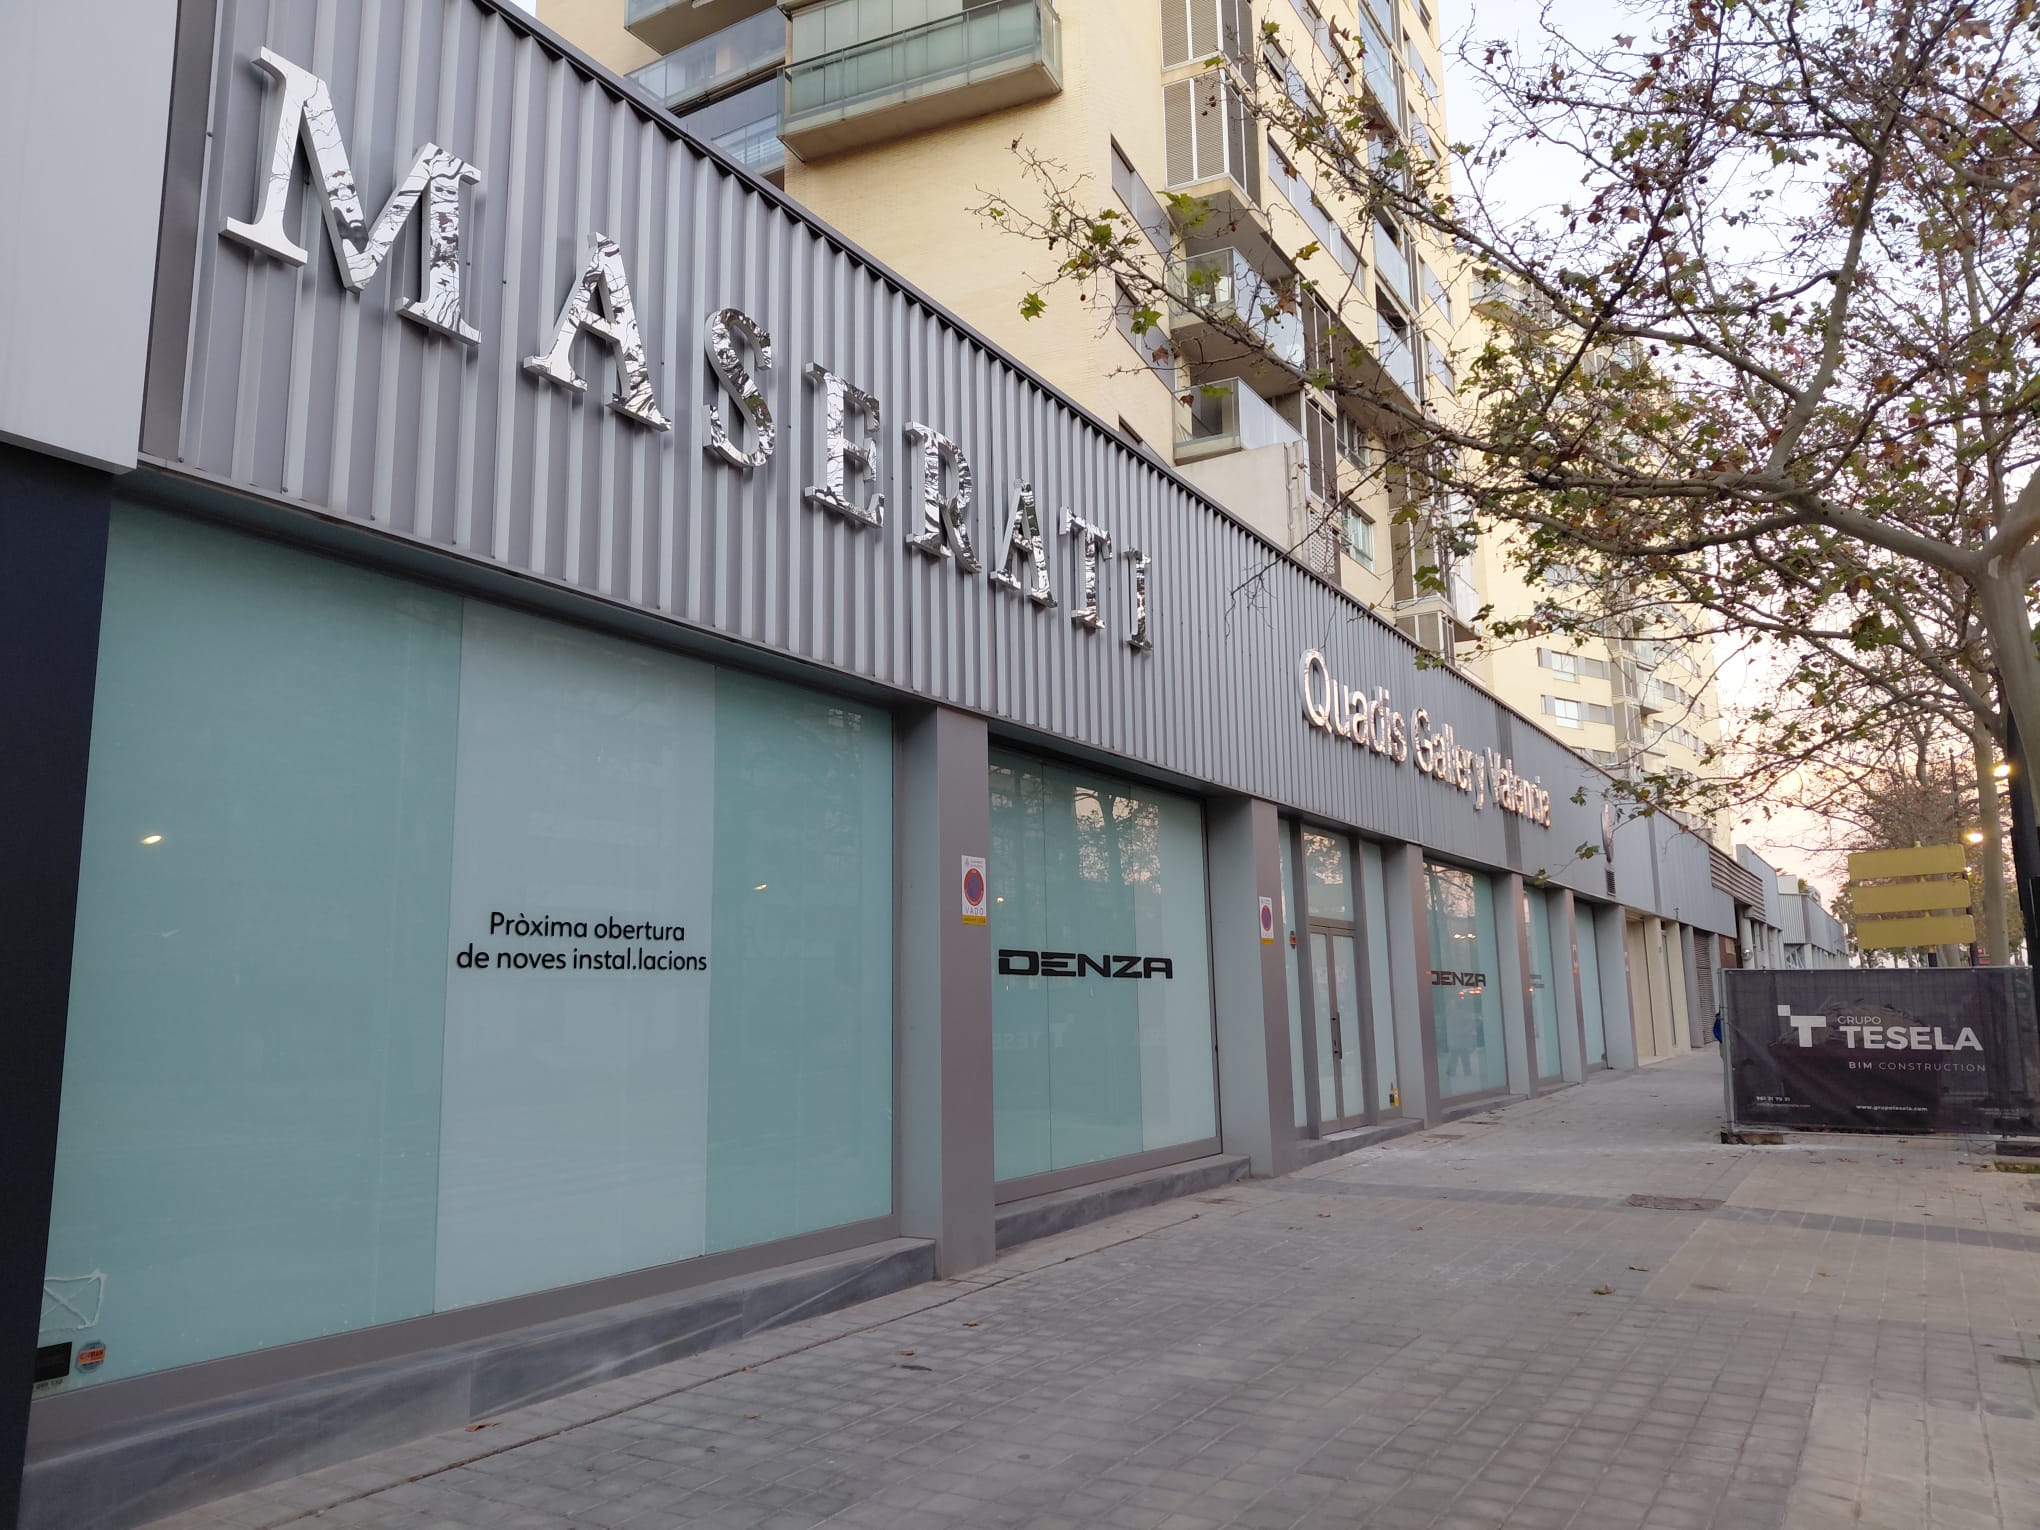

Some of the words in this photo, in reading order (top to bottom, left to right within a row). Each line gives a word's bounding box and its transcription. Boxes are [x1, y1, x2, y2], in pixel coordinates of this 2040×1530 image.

[219, 46, 1152, 651] MASERATI
[1300, 648, 1408, 762] Quadis
[1411, 707, 1485, 811] Gallery
[965, 907, 984, 916] VADO
[490, 911, 587, 938] Pròxima
[594, 916, 685, 941] obertura
[456, 943, 490, 969] de
[497, 951, 567, 969] noves
[573, 947, 708, 971] instal.lacions
[998, 949, 1173, 979] DENZA
[1837, 1015, 1882, 1025] GRUPO
[1839, 1025, 1984, 1050] TESELA
[1848, 1061, 1873, 1070] BIM
[1878, 1062, 1987, 1072] CONSTRUCTION
